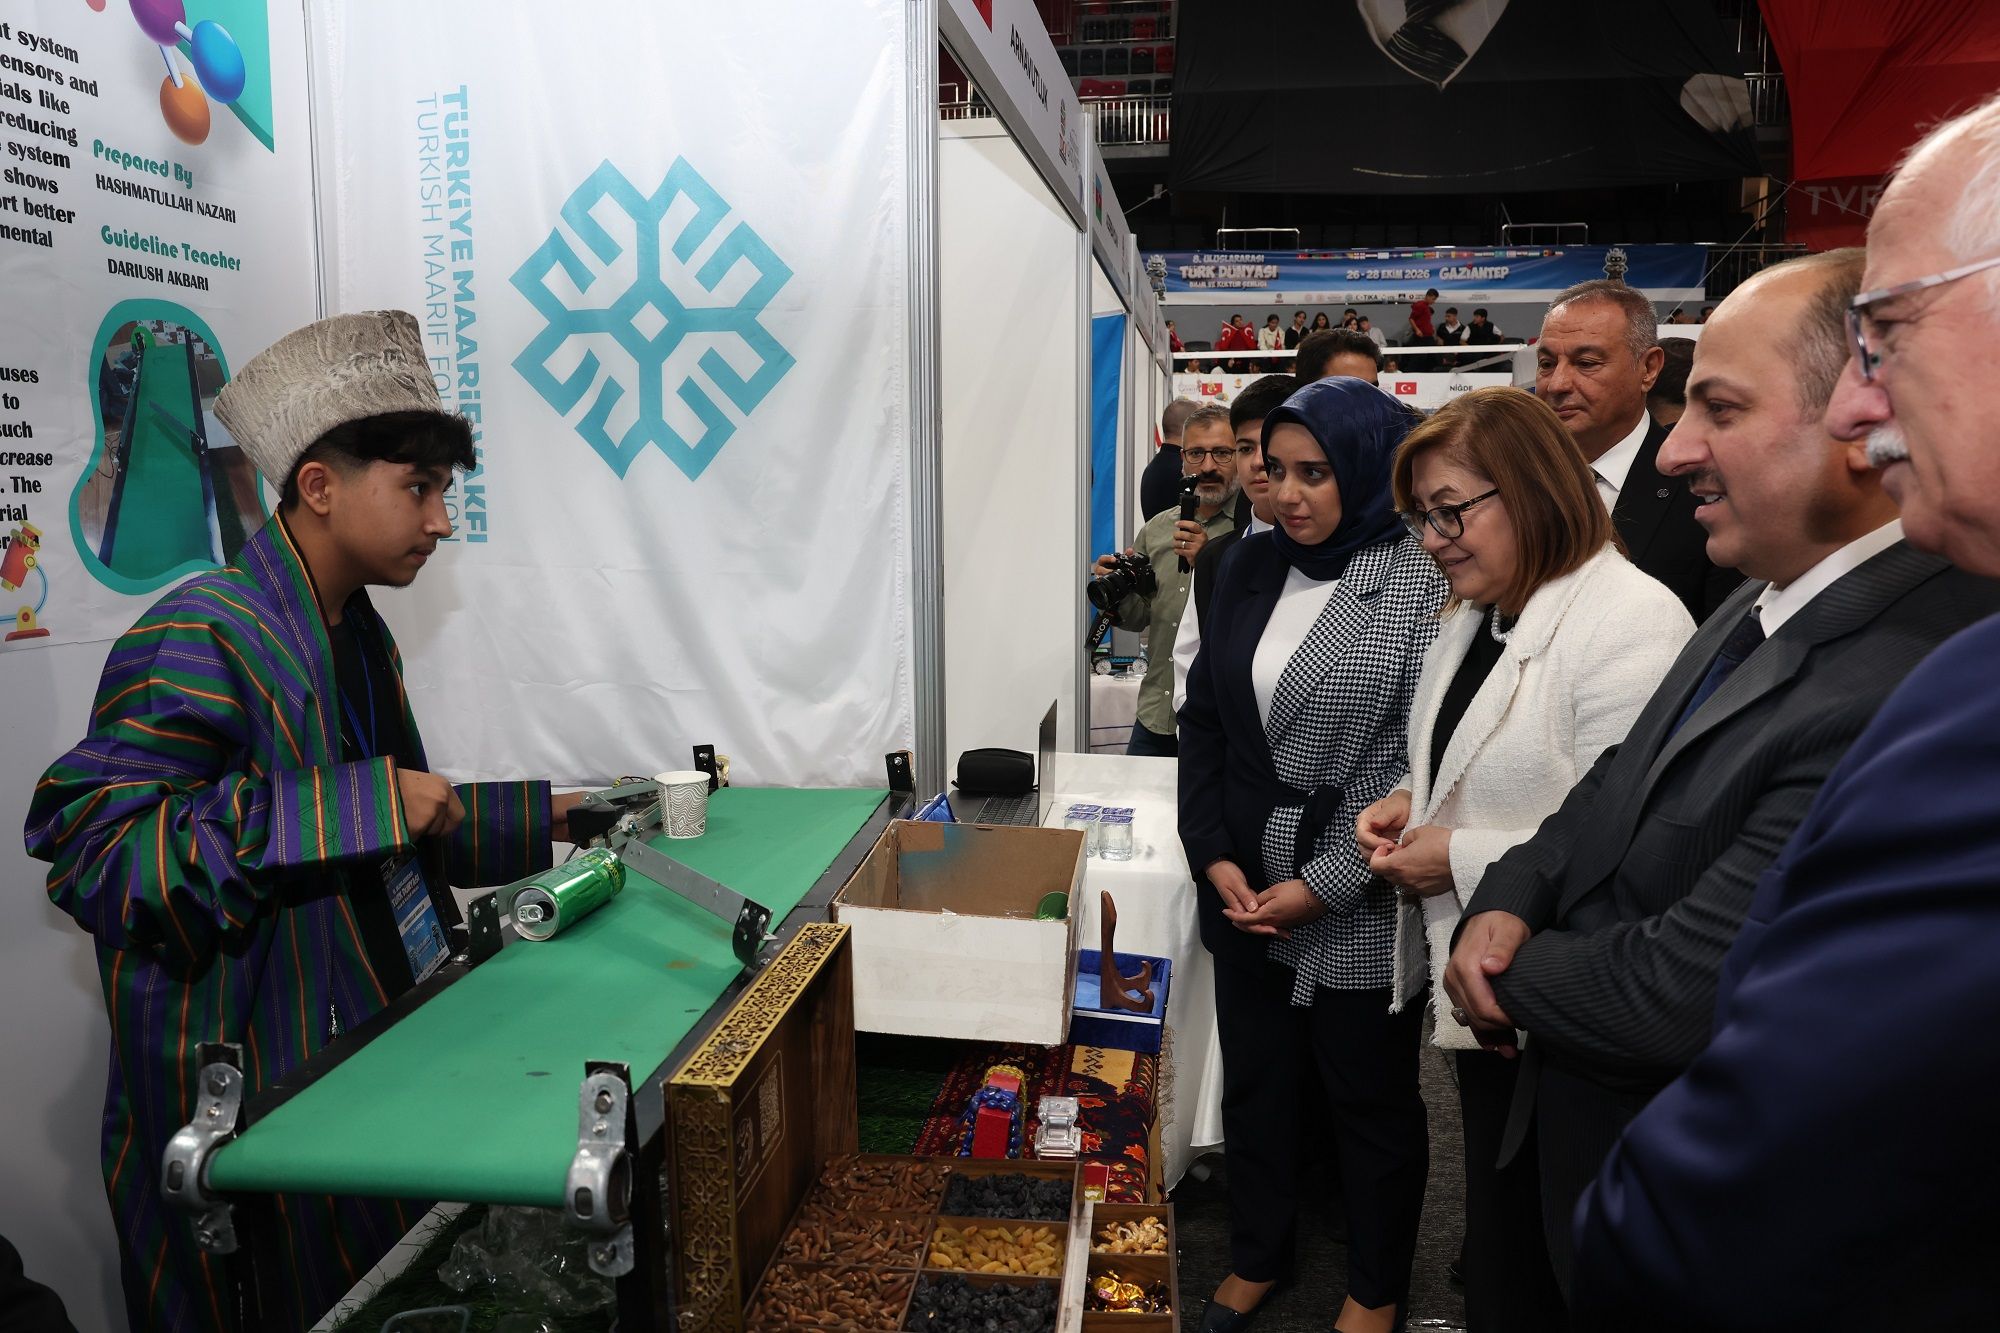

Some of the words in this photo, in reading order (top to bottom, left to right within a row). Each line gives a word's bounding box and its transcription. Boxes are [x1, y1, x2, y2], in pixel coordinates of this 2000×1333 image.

[17, 30, 79, 64] system
[0, 54, 64, 85] ensors
[69, 76, 99, 97] and
[39, 89, 70, 115] like
[0, 110, 78, 148] reducing
[7, 141, 71, 169] system
[93, 139, 169, 178] Prepared
[174, 163, 193, 189] By
[416, 92, 443, 222] TURKISH
[4, 166, 59, 194] shows
[23, 197, 76, 224] better
[95, 173, 193, 213] HASHMATULLAH
[197, 201, 236, 223] NAZARI
[0, 223, 53, 248] mental
[101, 225, 178, 258] Guideline
[181, 243, 241, 271] Teacher
[107, 258, 164, 283] DARIUSH
[167, 273, 209, 292] AKBARI
[1179, 265, 1216, 279] TÜRK
[1218, 264, 1279, 279] DÜNYASI
[422, 234, 450, 346] MAARIF
[0, 367, 39, 383] uses
[2, 392, 20, 410] to
[0, 451, 53, 466] crease
[10, 476, 42, 493] The
[1092, 617, 1110, 643] SONY
